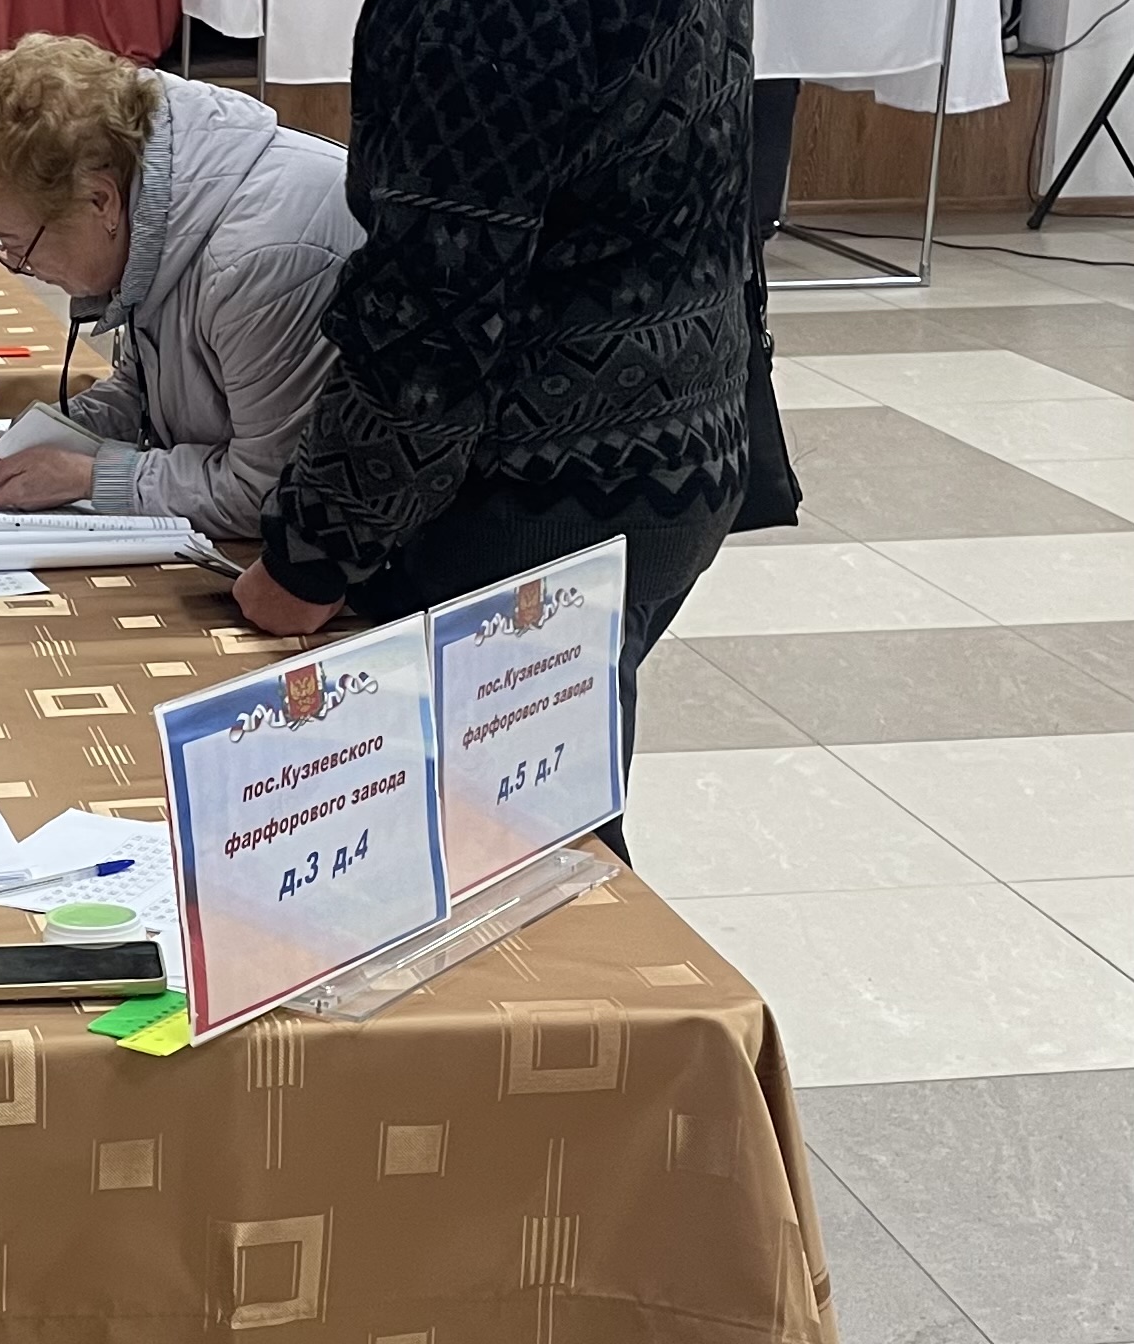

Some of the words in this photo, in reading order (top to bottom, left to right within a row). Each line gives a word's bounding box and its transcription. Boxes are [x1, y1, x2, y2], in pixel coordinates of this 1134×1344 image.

[477, 644, 581, 700] пос.Кузяевского
[462, 696, 549, 750] фарфорового
[553, 676, 594, 706] завода
[242, 735, 384, 803] пос.Кузяевского
[497, 760, 527, 805] д.5
[535, 742, 565, 787] д.7
[224, 794, 346, 859] фарфорового
[350, 770, 406, 806] завода
[278, 851, 319, 901] д.3
[332, 828, 369, 879] д.4
